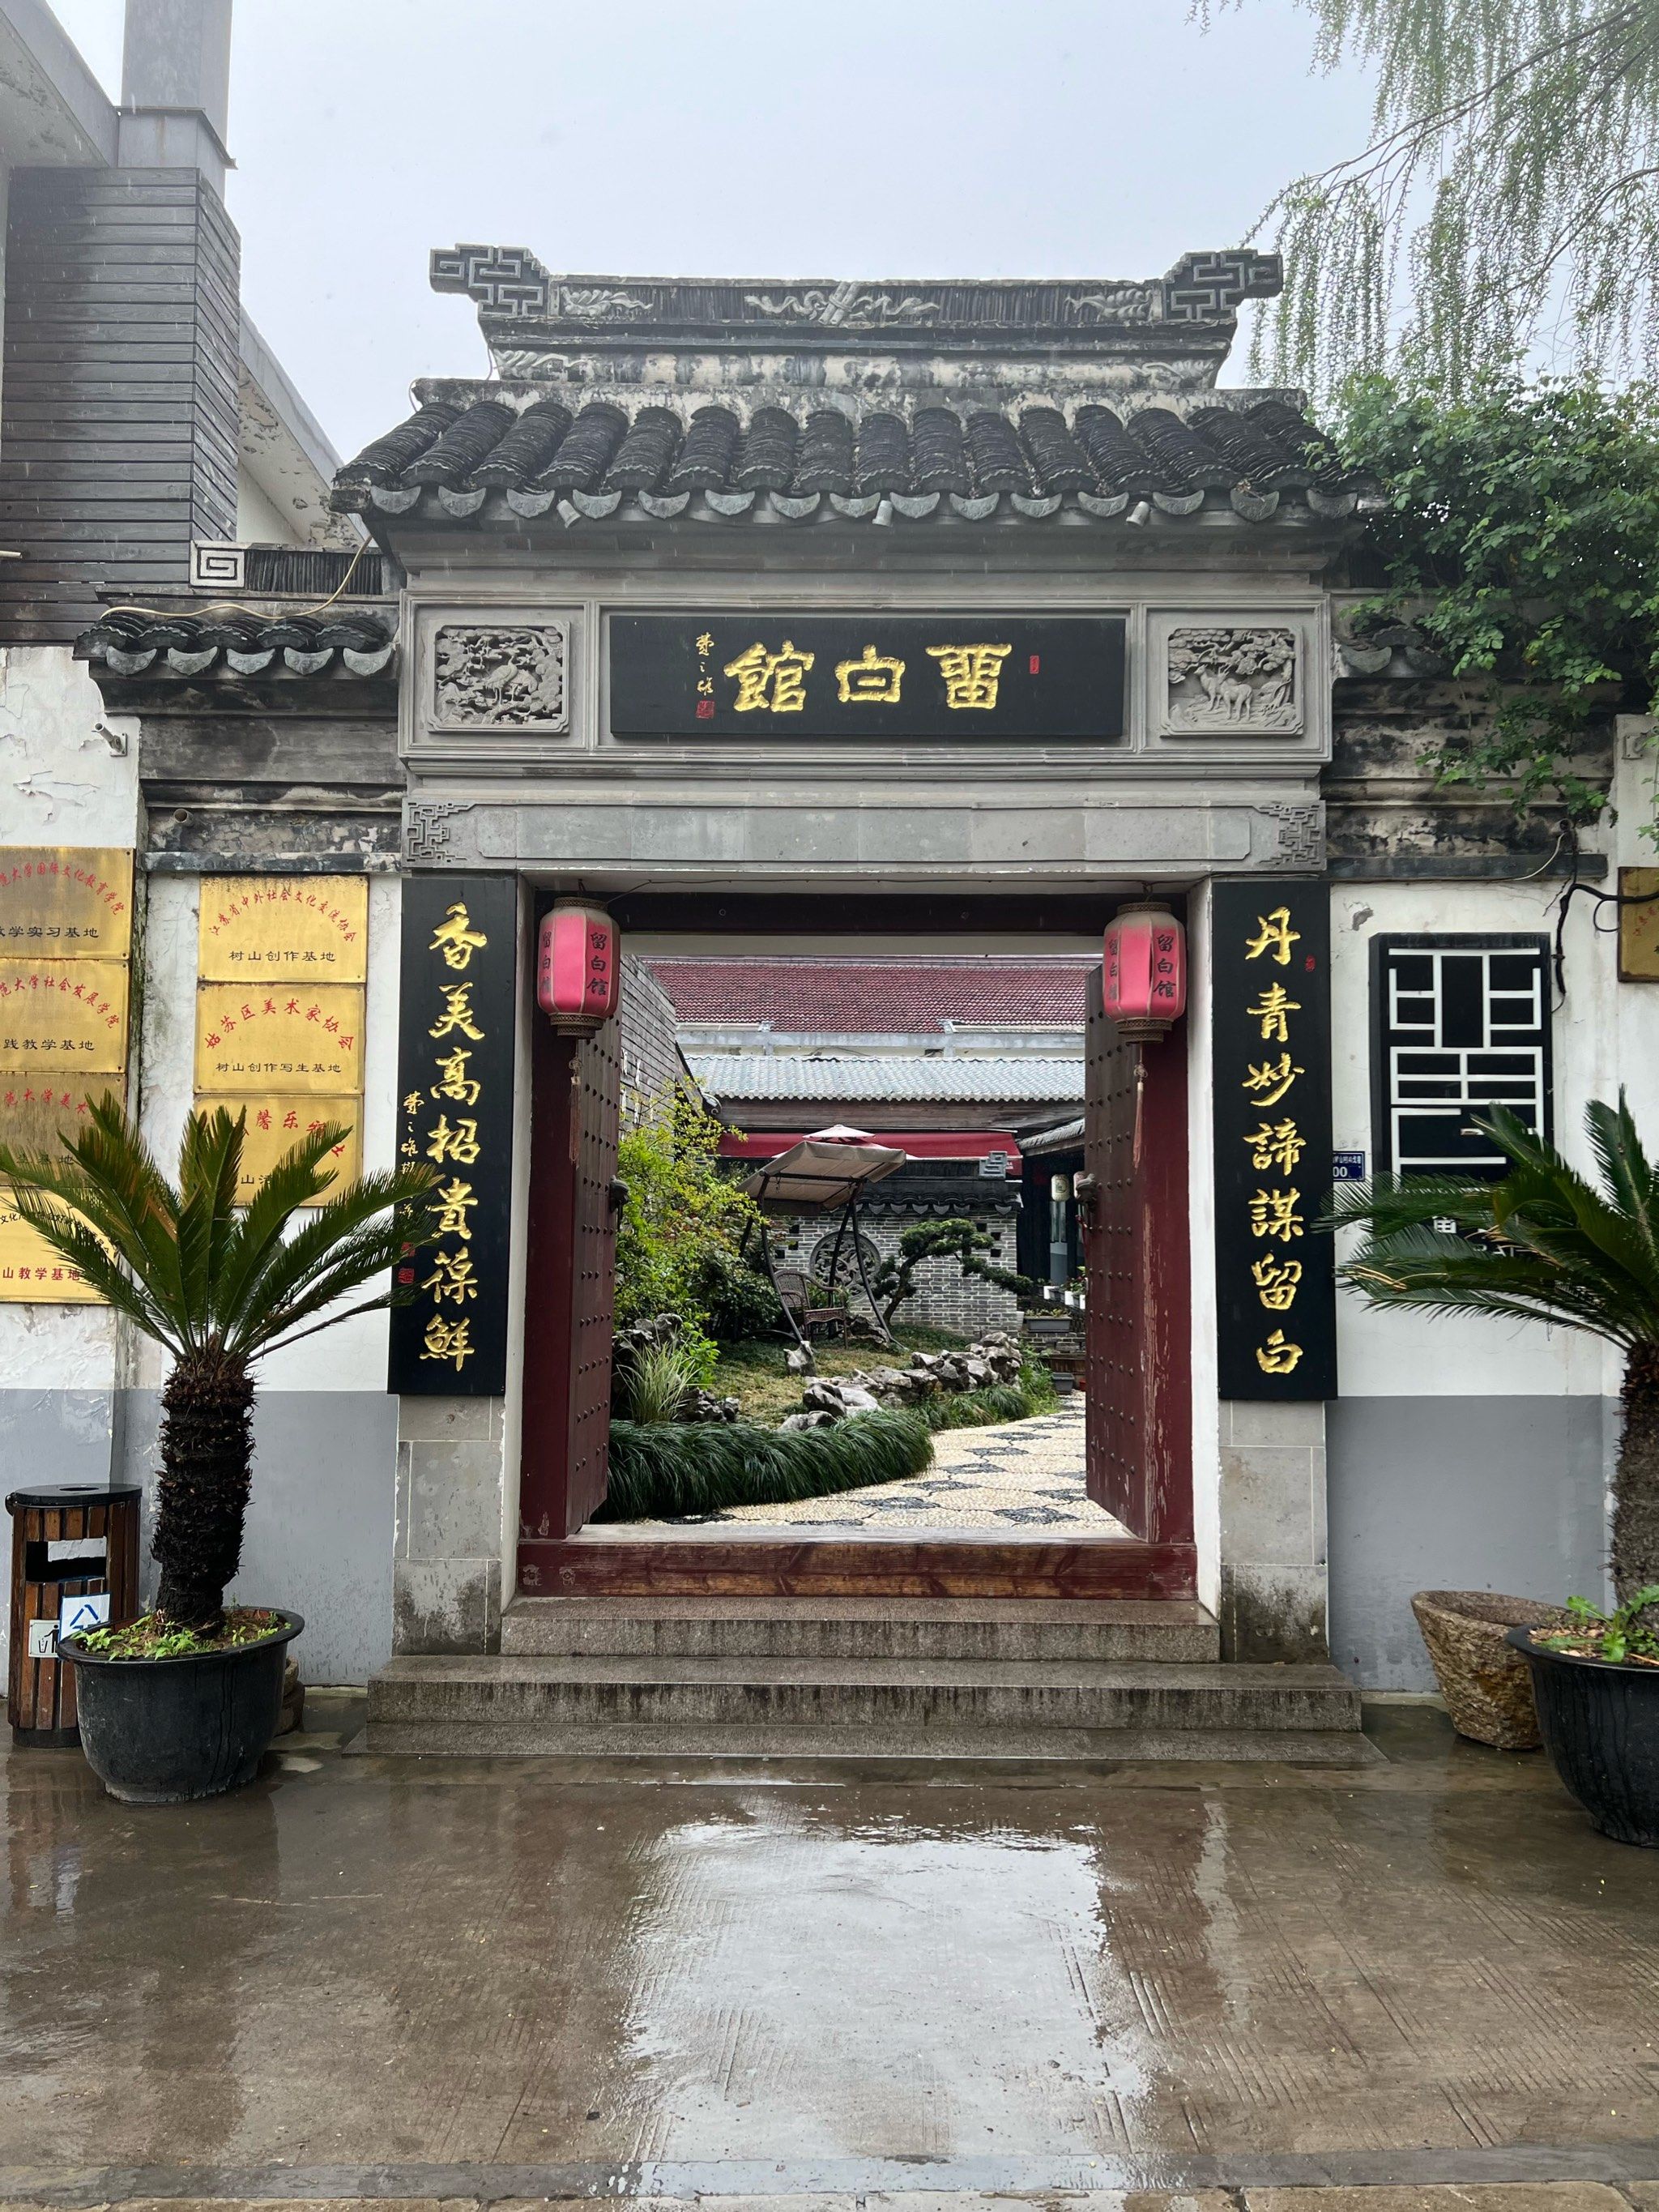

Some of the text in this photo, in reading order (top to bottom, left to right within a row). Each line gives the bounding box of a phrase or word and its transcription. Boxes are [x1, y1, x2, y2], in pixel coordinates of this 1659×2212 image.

[228, 950, 337, 963] 树山创作基地
[543, 931, 552, 995] 留白
[586, 932, 609, 996] 留白馆
[1153, 934, 1177, 998] 留白馆
[204, 997, 355, 1051] 姑苏区美术家协会
[215, 1062, 343, 1074] 树山创作写生基地
